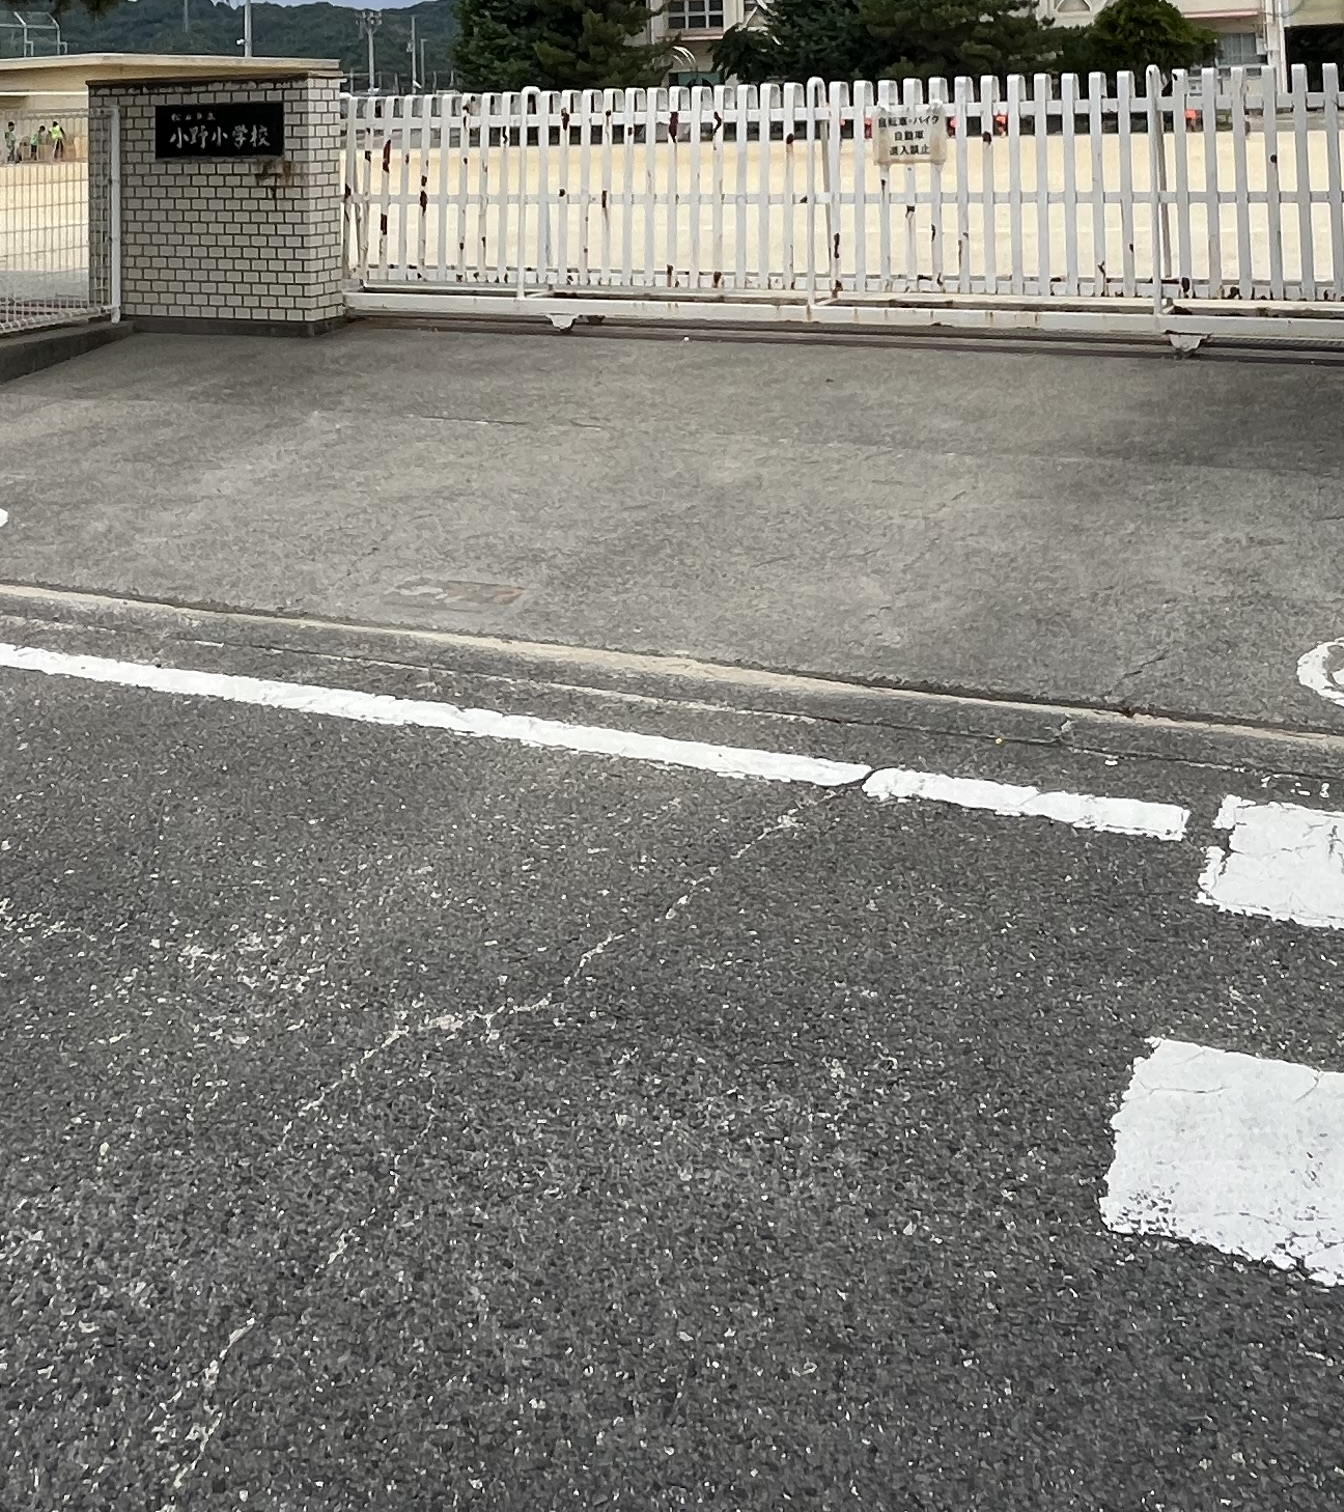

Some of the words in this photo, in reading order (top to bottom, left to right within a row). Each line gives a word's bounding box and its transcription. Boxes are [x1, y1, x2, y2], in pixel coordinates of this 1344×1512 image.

[168, 123, 272, 150] 小野小学校
